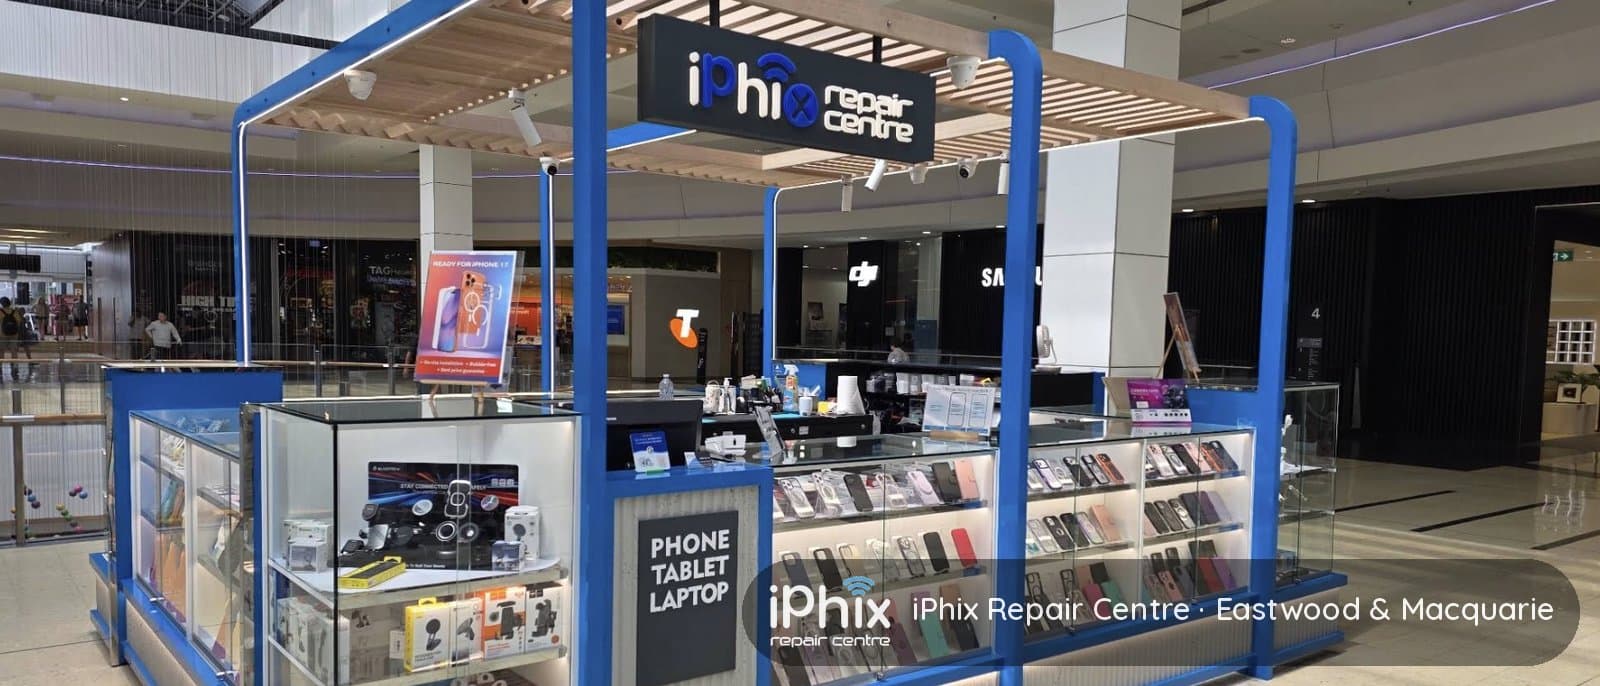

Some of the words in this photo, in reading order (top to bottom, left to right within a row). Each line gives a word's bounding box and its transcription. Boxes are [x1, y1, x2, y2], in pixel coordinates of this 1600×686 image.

[825, 85, 914, 118] repair
[824, 110, 914, 143] centre
[1312, 308, 1320, 319] 4
[651, 529, 730, 559] PHONE
[651, 554, 730, 585] TABLET
[650, 581, 730, 613] LAPTOP
